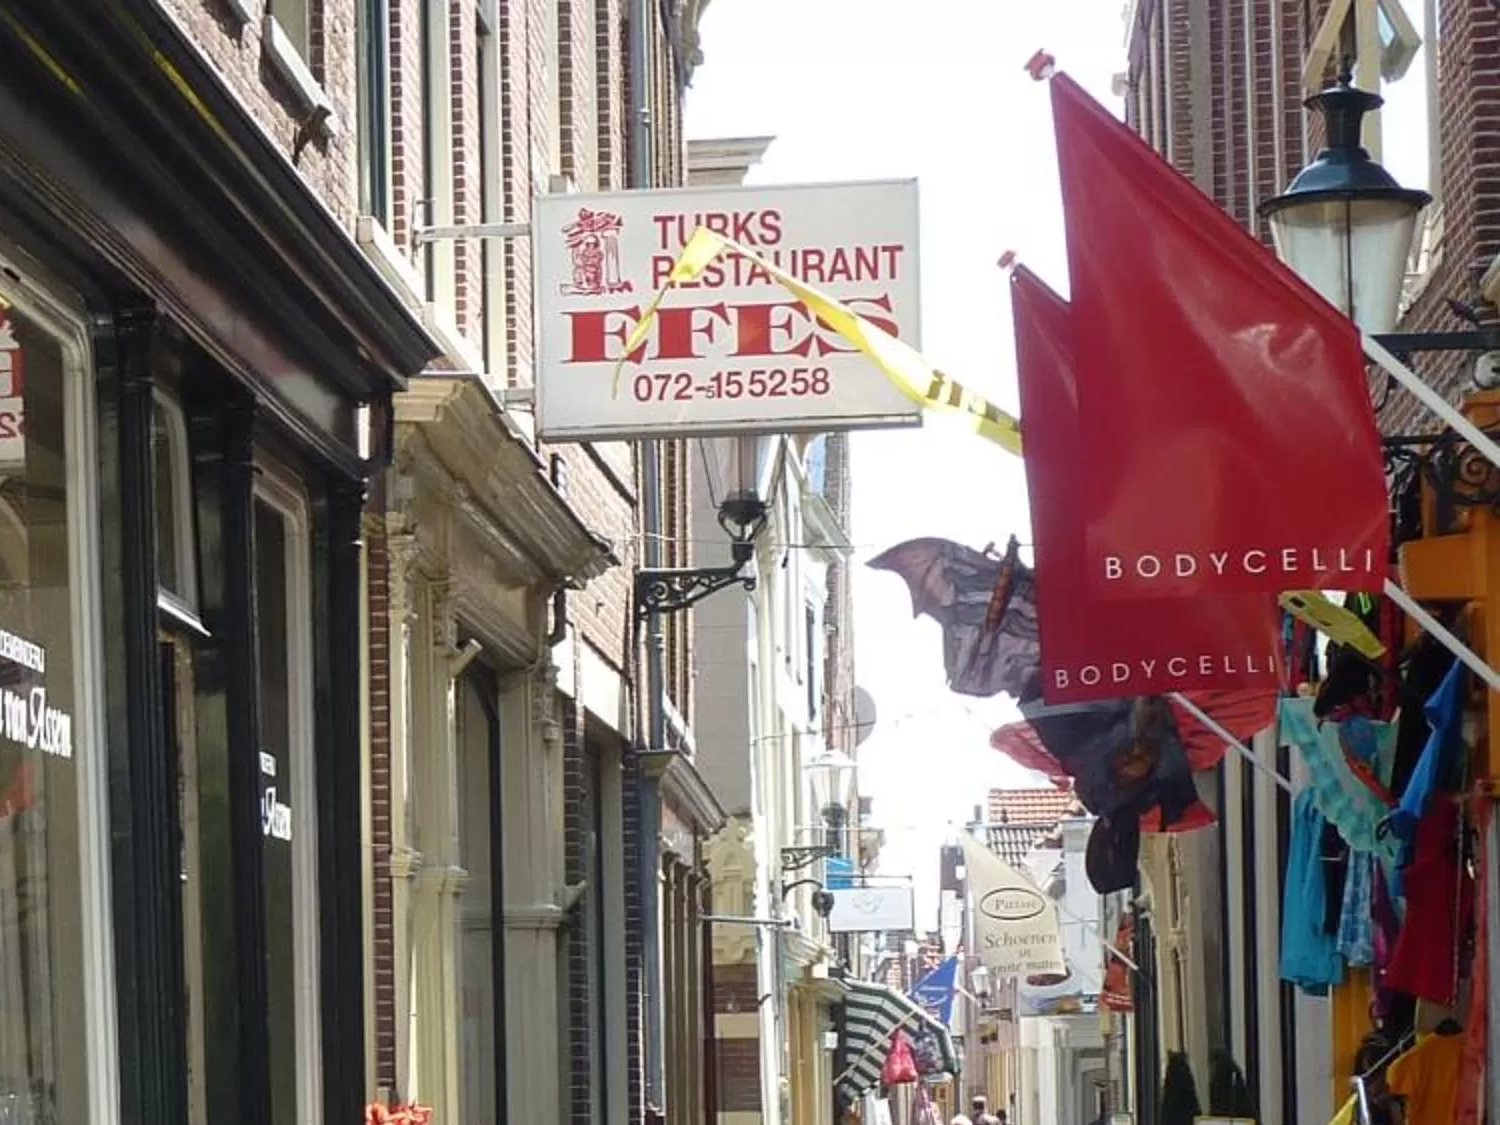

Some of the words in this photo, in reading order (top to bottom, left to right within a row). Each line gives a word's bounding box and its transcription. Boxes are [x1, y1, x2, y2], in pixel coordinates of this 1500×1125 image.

[1104, 548, 1372, 579] BODYCELLI
[1054, 655, 1275, 689] BODYCELLI
[27, 686, 72, 759] Assem
